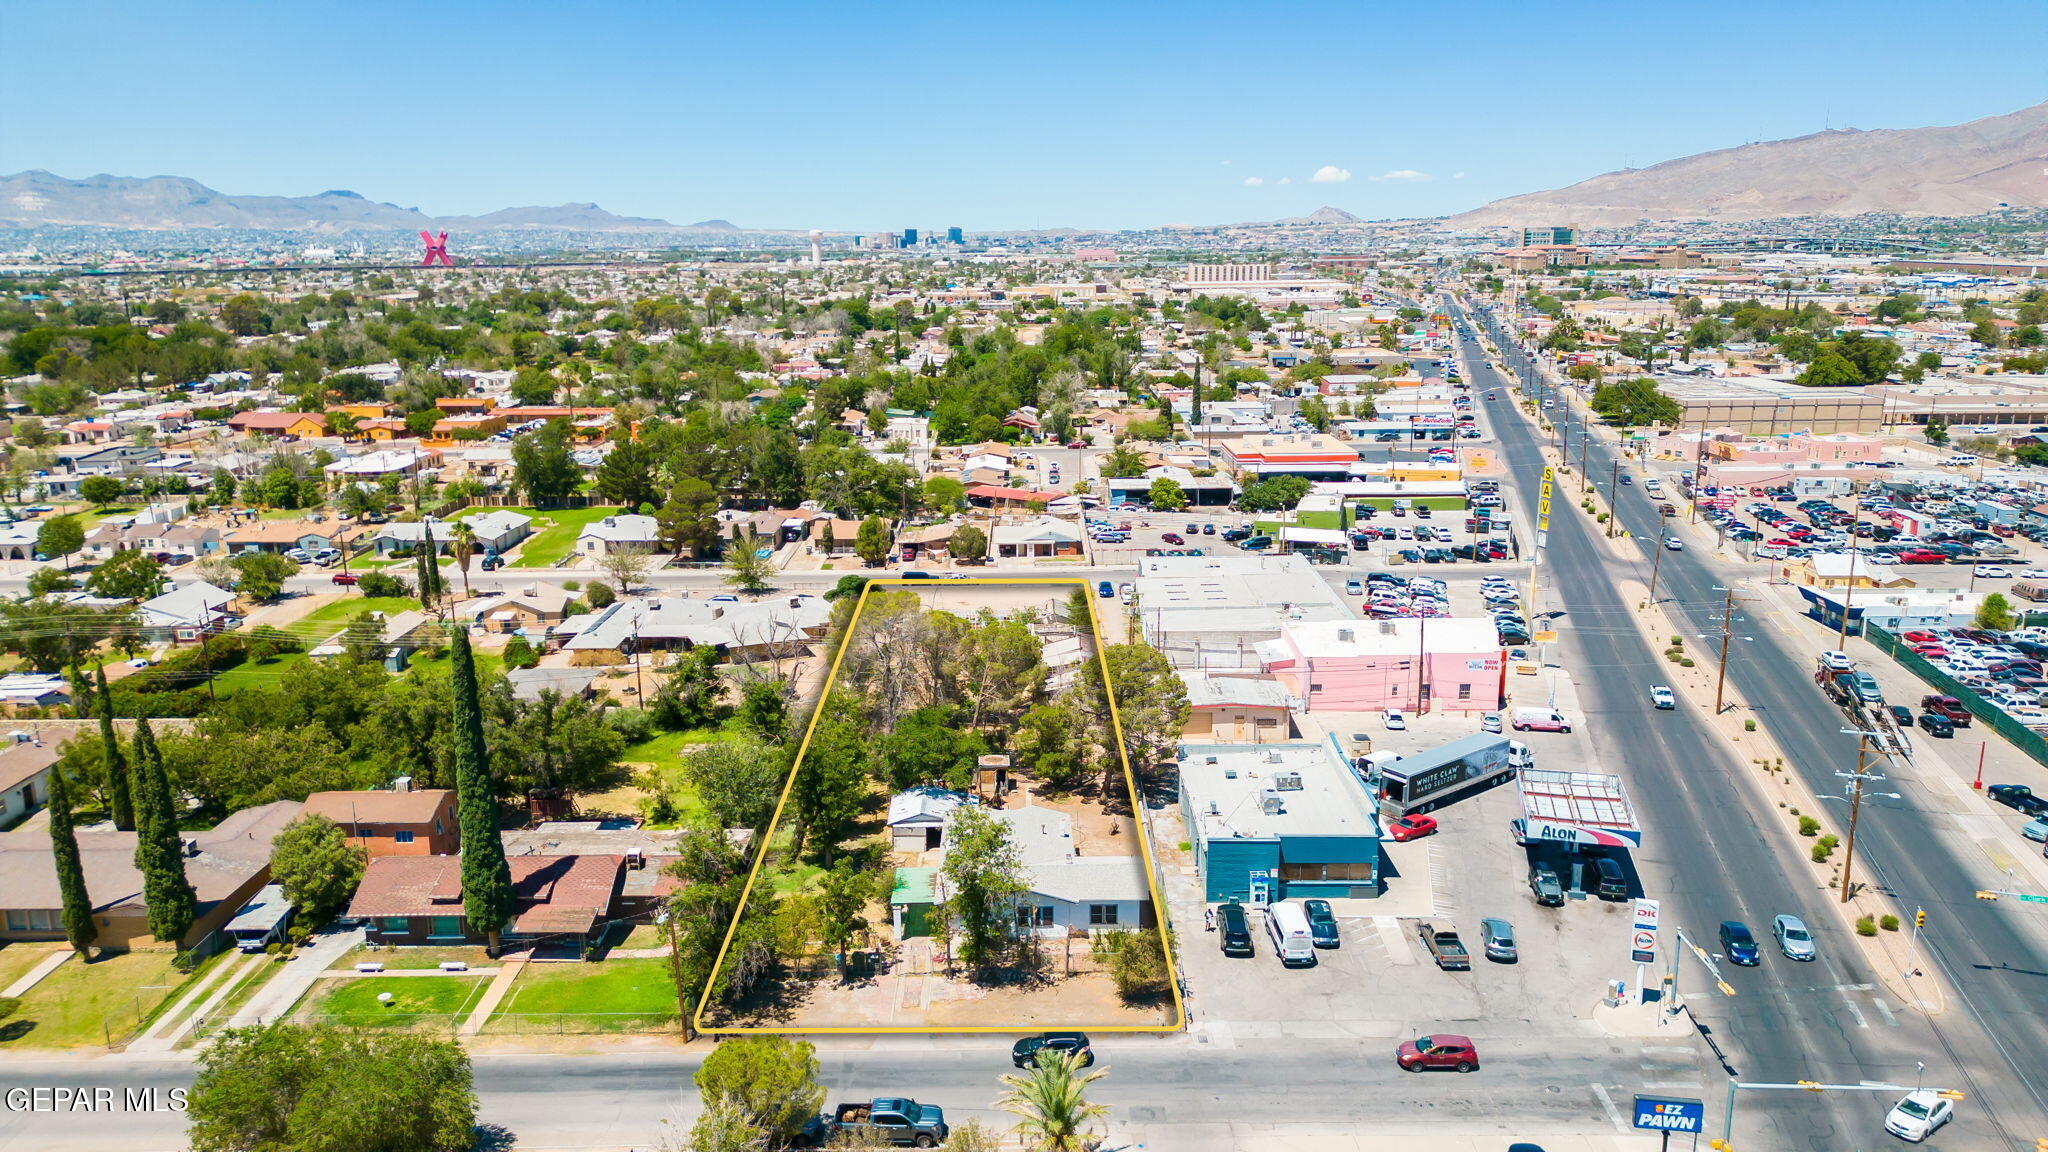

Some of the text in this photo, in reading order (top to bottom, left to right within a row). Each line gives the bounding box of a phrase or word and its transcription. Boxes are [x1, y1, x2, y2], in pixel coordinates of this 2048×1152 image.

[1416, 766, 1458, 786] WHITE CLAW
[1416, 774, 1457, 793] HARD SELTZER
[1541, 825, 1577, 840] ALON
[1637, 909, 1656, 918] DK
[1664, 1104, 1684, 1115] EZ
[1638, 1113, 1697, 1130] PAWN
